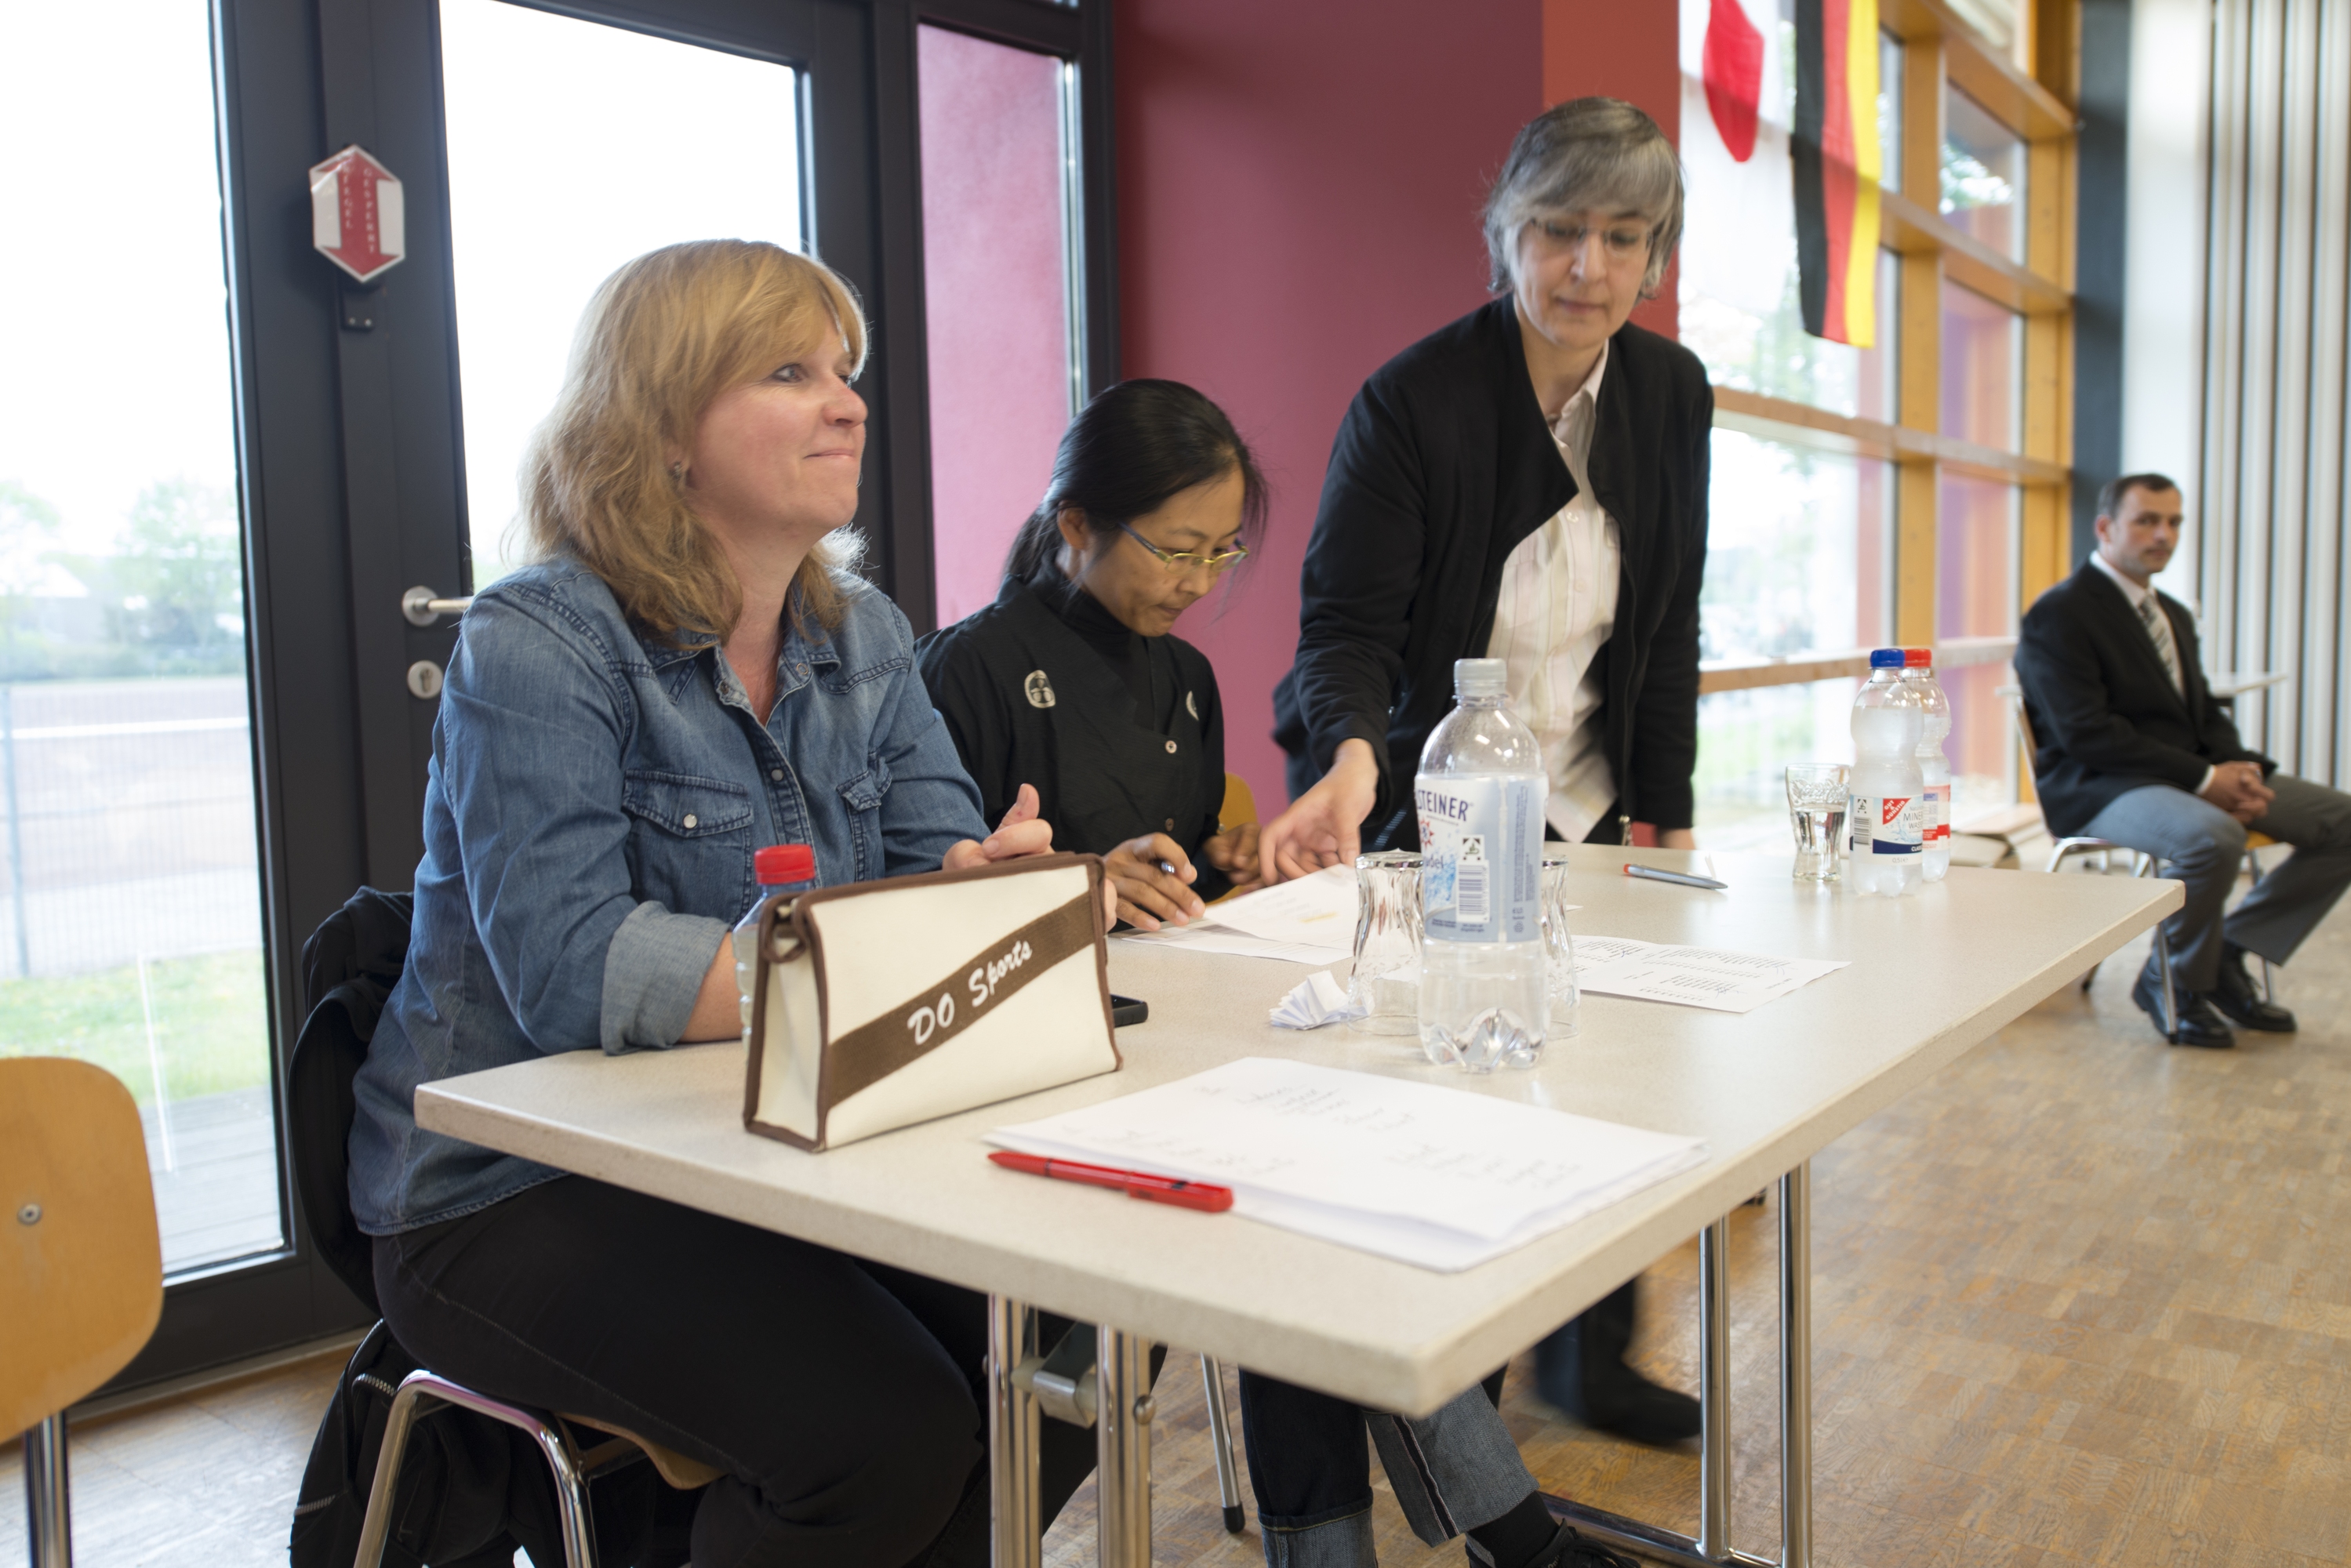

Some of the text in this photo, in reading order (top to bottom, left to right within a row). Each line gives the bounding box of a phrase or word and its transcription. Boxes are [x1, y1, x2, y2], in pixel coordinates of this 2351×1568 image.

[363, 168, 376, 254] GESPERRT
[1884, 800, 1895, 810] GUT
[907, 940, 1033, 1045] DO Sports
